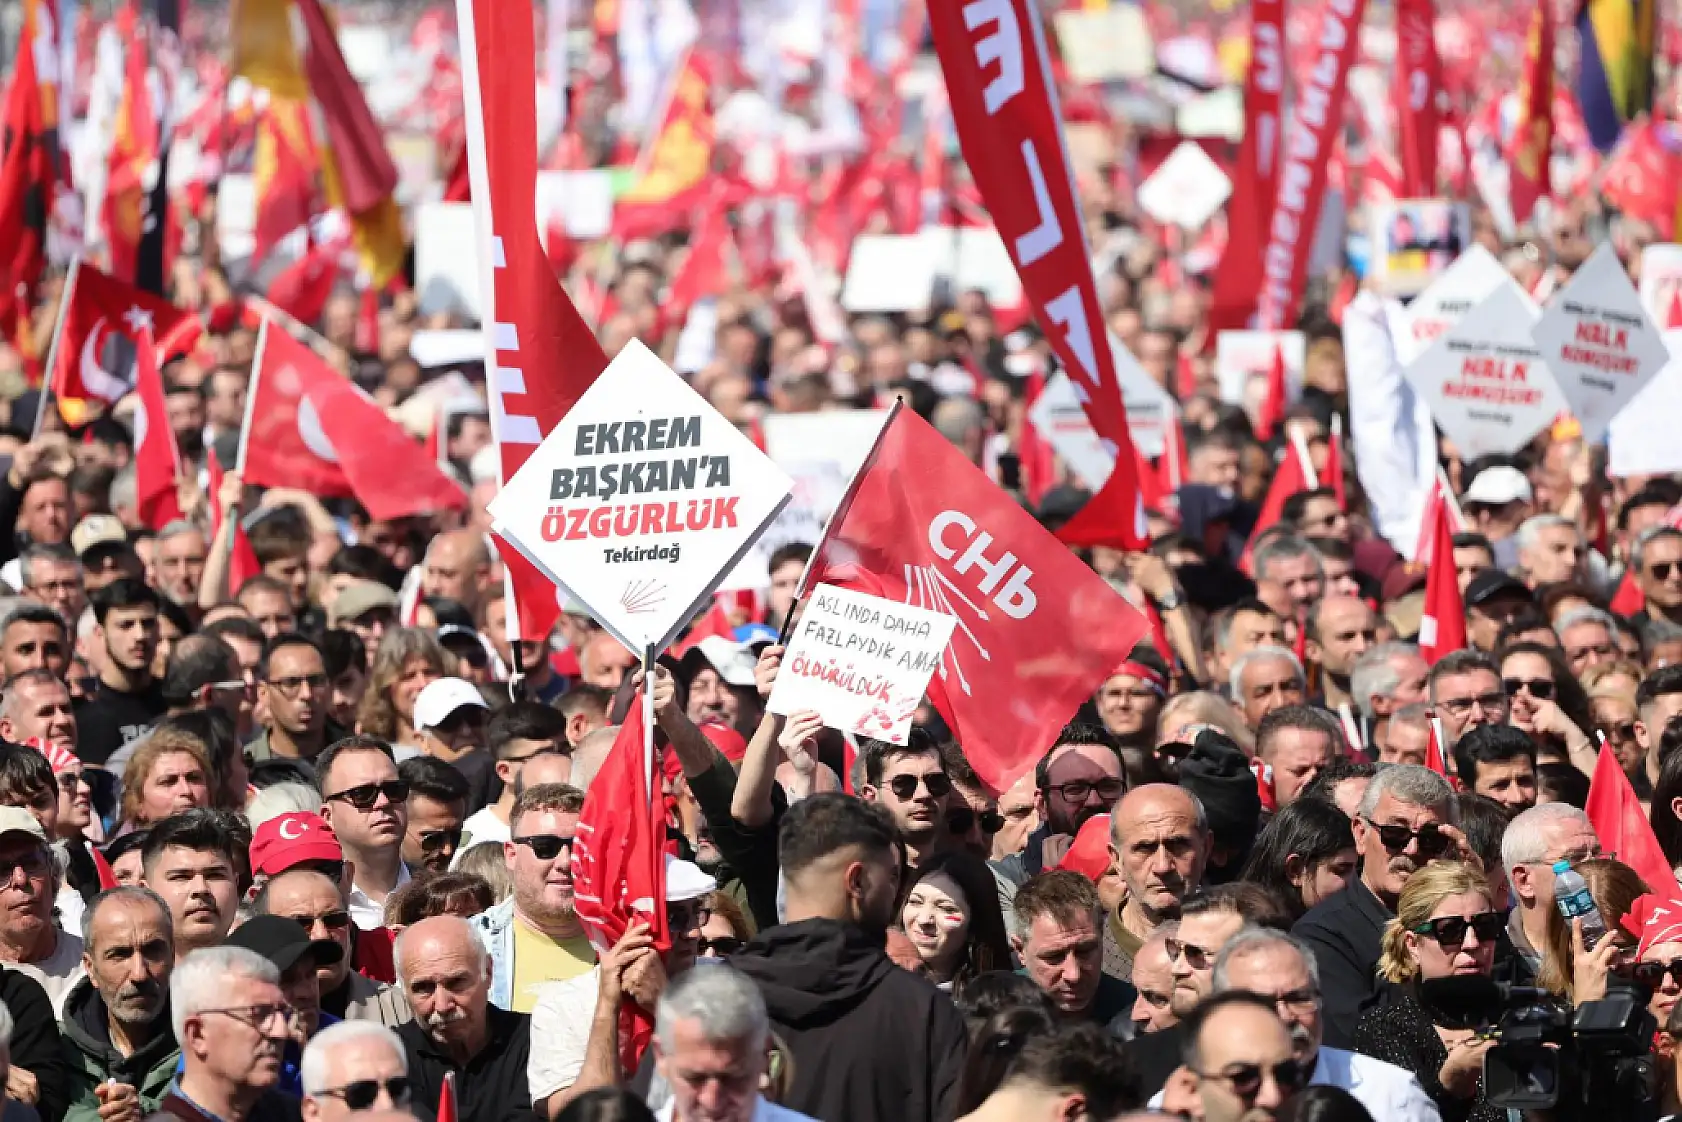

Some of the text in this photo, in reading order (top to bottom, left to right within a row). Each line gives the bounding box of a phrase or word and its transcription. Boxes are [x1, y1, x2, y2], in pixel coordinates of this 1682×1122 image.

[574, 416, 701, 456] EKREM
[550, 455, 730, 501] BAŞKAN'A
[541, 497, 739, 542] ÖZGÜRLÜK
[604, 543, 680, 563] Tekirdağ
[817, 596, 931, 637] ASLINDA DAHA
[805, 621, 940, 672] FAZLAYDIK AMA
